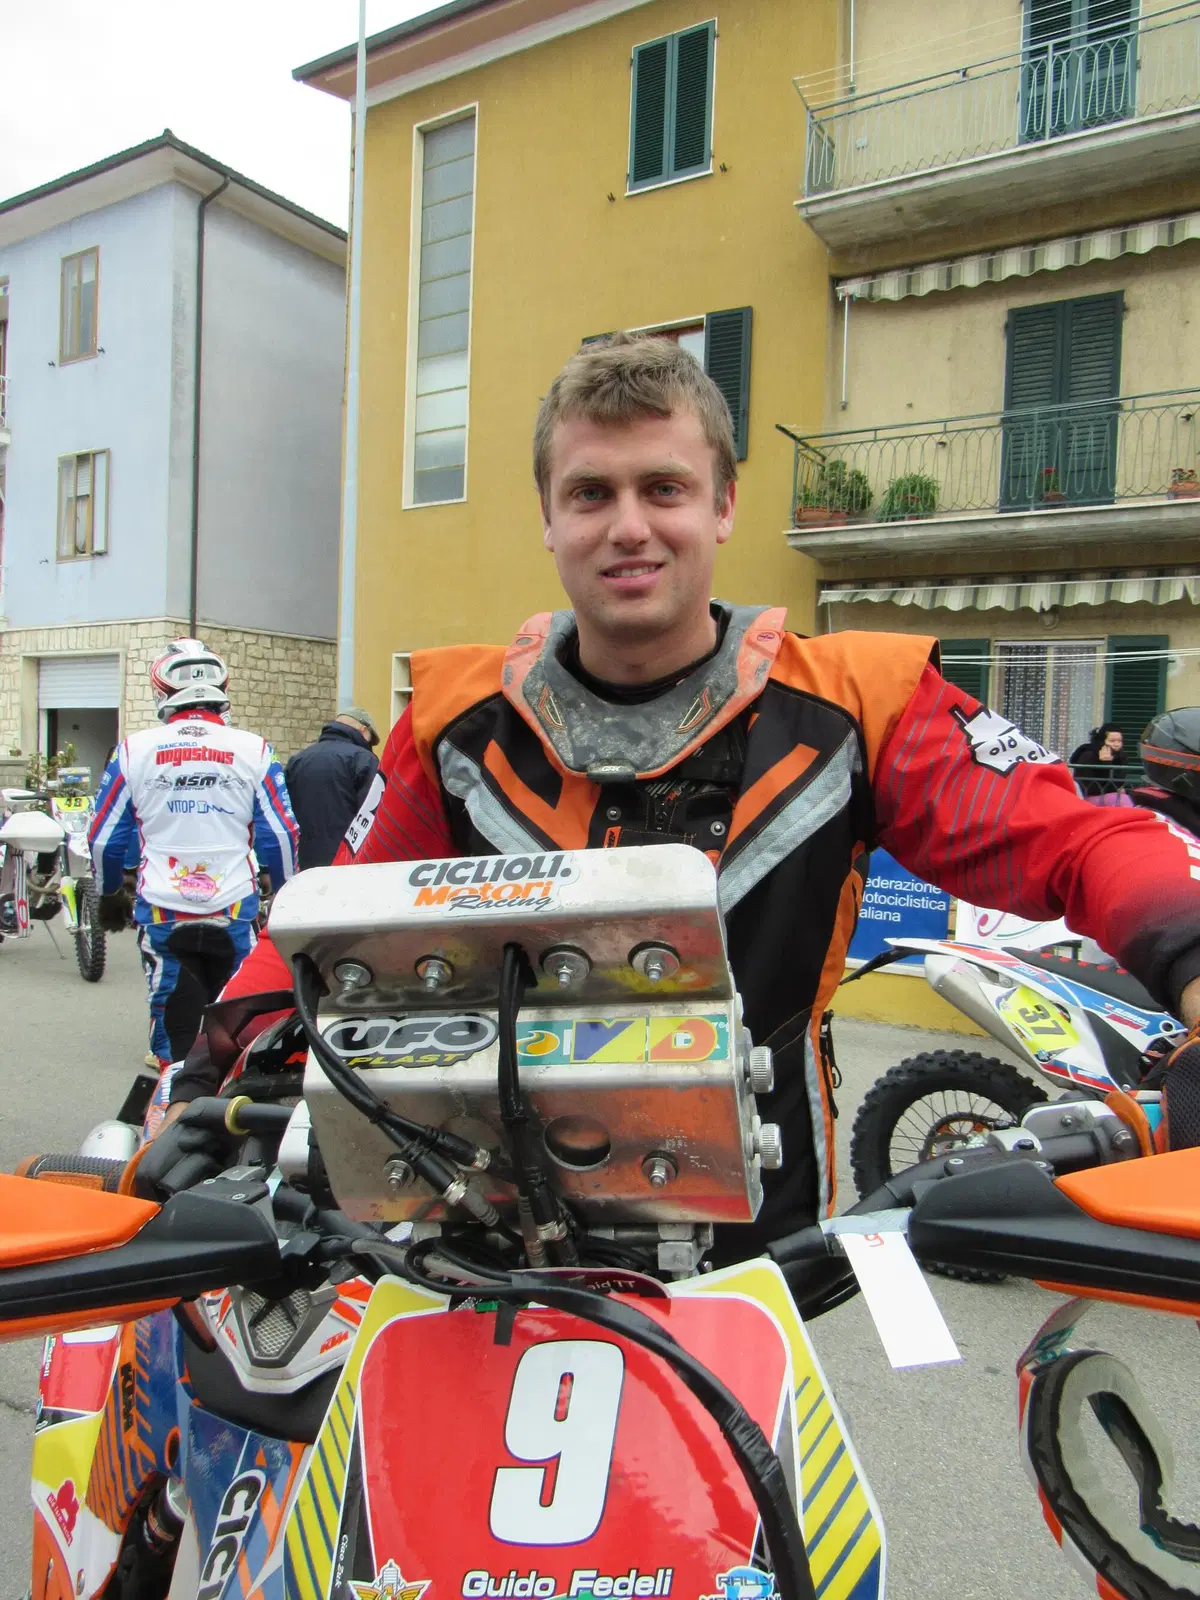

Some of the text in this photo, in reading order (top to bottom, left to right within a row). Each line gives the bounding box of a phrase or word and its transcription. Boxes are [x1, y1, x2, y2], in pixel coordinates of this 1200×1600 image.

[989, 736, 1018, 756] old
[167, 801, 196, 814] VITOP
[414, 881, 553, 907] Motori
[449, 895, 553, 912] Racing
[862, 892, 946, 911] otociclistica
[1017, 1004, 1066, 1036] 37
[329, 1019, 490, 1052] UFO
[347, 1053, 466, 1067] PLAST
[319, 1330, 349, 1354] KTM
[488, 1338, 626, 1547] 9
[461, 1567, 674, 1598] Guido Fedeli
[718, 1574, 774, 1587] RALLY
